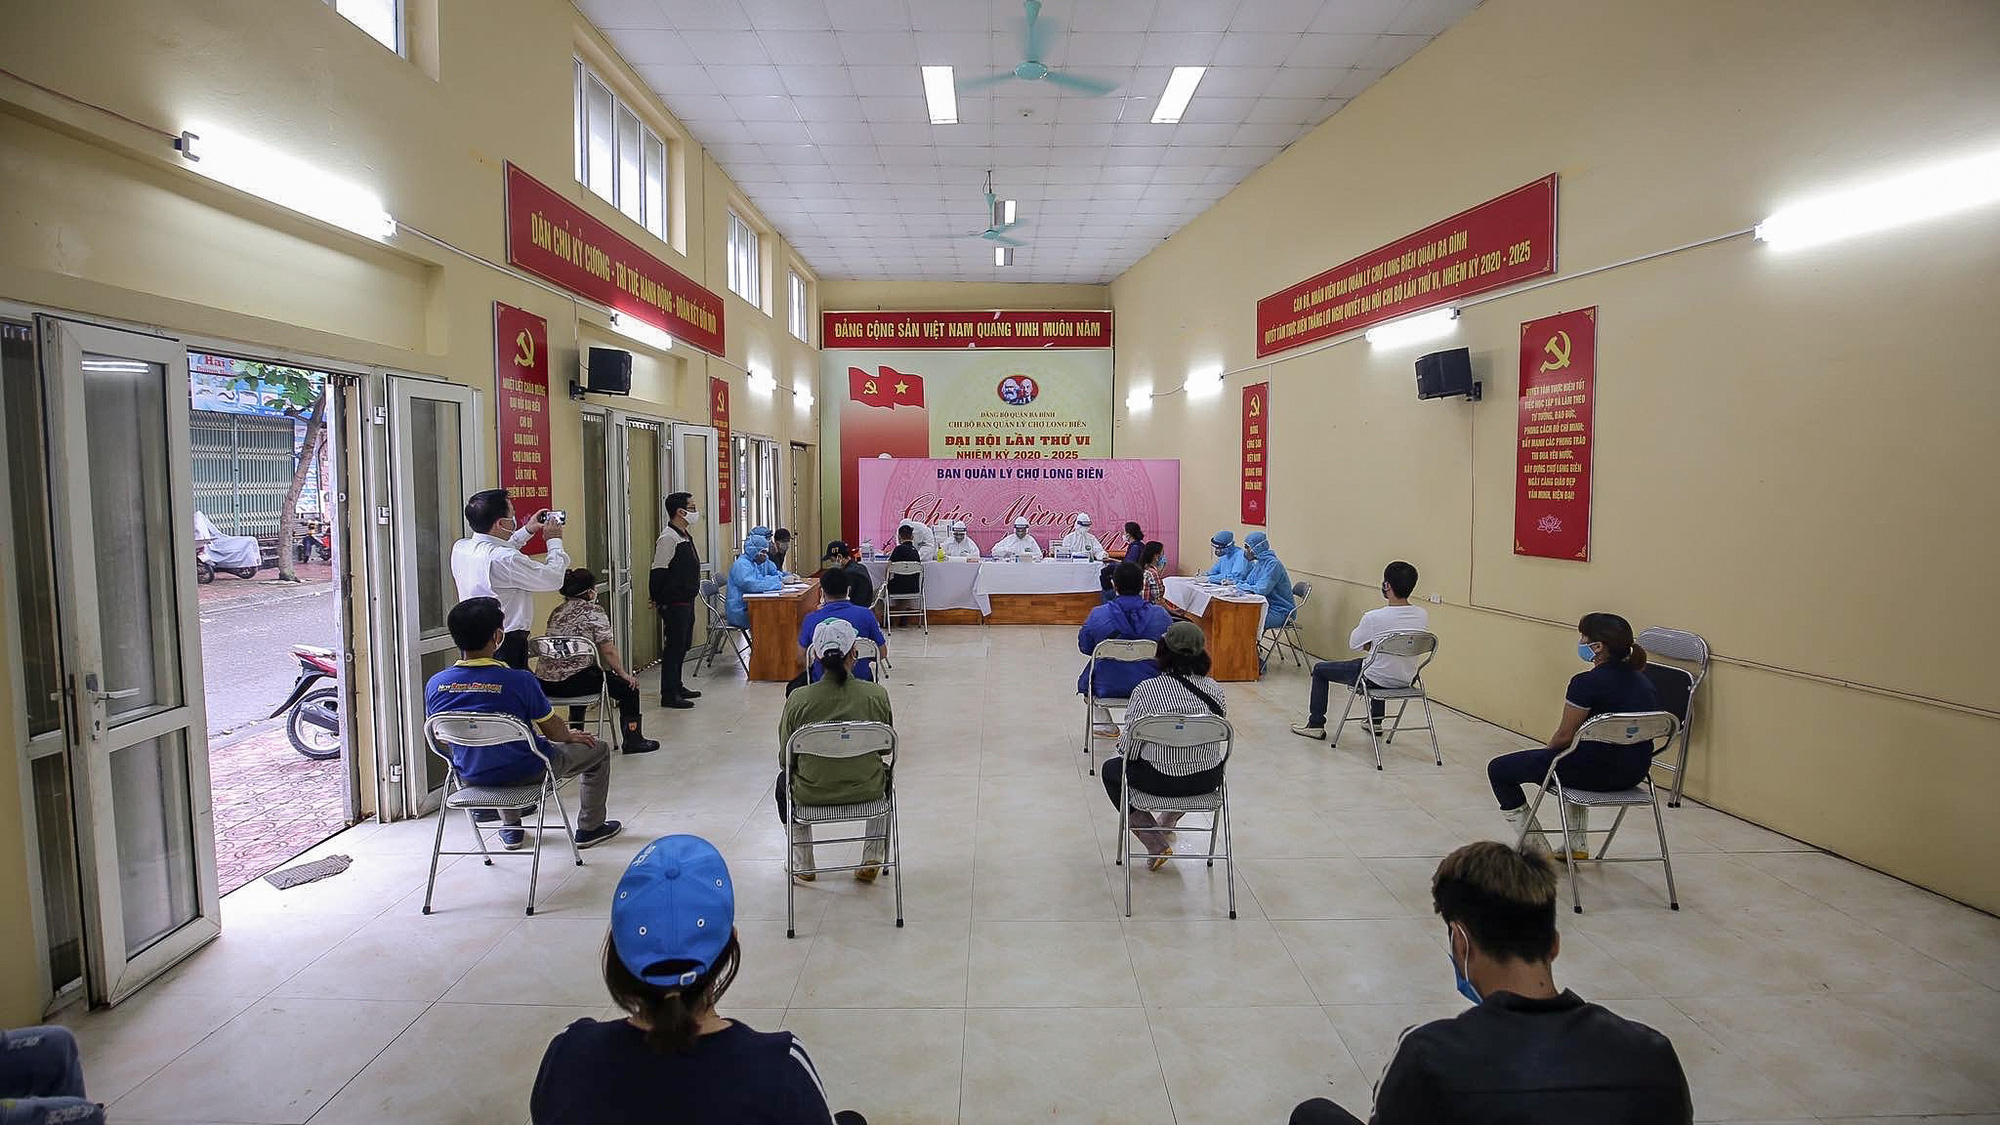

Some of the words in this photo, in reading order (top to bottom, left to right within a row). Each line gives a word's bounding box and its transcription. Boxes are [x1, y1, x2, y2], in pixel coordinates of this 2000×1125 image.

[532, 211, 551, 251] DÂN
[554, 220, 570, 262] CHỦ
[585, 244, 610, 282] CƯƠNG
[628, 268, 640, 302] TUỆ
[1384, 257, 1400, 278] LONG
[1401, 249, 1416, 272] BIÊN
[1418, 241, 1436, 268] QUẬN
[1438, 238, 1448, 258] BA
[1449, 230, 1468, 254] ĐÌNH
[1418, 269, 1432, 295] THỨ
[1442, 260, 1467, 288] NHIỆM
[1468, 254, 1480, 279] KỲ
[1480, 250, 1501, 276] 2020
[1508, 240, 1531, 266] 2025
[835, 318, 863, 338] ĐẢNG
[867, 320, 894, 340] CỘNG
[898, 318, 920, 338] SẢN
[923, 320, 945, 340] VIỆT
[948, 322, 974, 337] NAM
[978, 322, 1012, 338] QUANG
[1016, 322, 1039, 336] VINH
[1043, 320, 1073, 336] MUÔN
[1076, 320, 1100, 336] NĂM
[964, 420, 975, 430] BỘ
[1028, 421, 1044, 429] CHỢ
[1069, 420, 1087, 428] BIÊN
[945, 436, 970, 448] ĐẠI
[975, 433, 1000, 448] HỘI
[1006, 432, 1035, 446] LẦN
[1040, 433, 1072, 446] THỨ
[1075, 436, 1090, 446] VI
[996, 449, 1009, 459] KỲ
[1014, 450, 1041, 460] 2020
[1052, 450, 1078, 460] 2025
[937, 468, 960, 479] BAN
[964, 466, 996, 480] QUẢN
[1000, 466, 1013, 479] LÝ
[1016, 468, 1040, 481] CHỢ
[1043, 468, 1074, 479] LONG
[1077, 467, 1104, 479] BIÊN
[902, 492, 974, 527] Chúc
[981, 494, 1079, 540] Mừng
